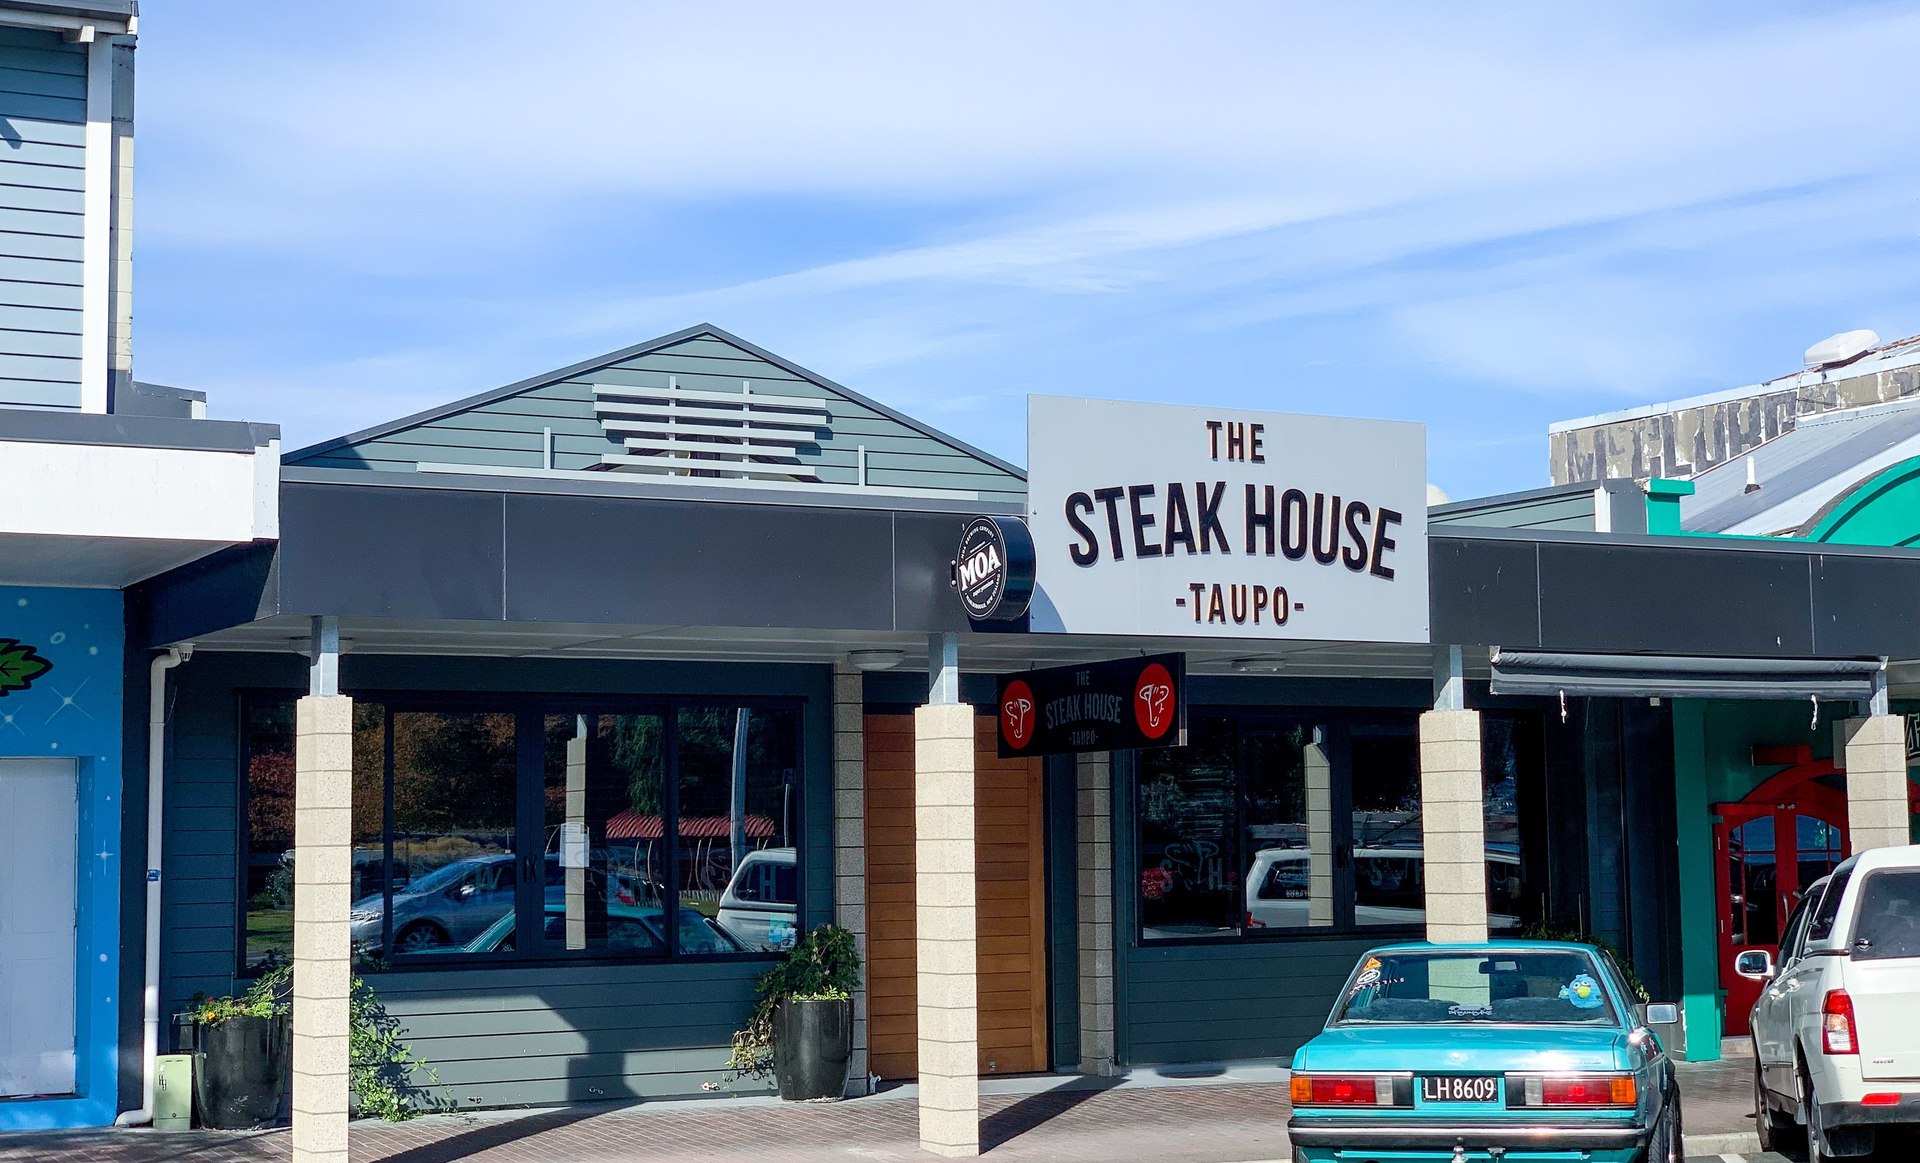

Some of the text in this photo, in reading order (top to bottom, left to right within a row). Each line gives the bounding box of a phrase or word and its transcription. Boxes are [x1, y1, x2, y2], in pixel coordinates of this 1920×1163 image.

[1207, 420, 1266, 463] THE
[1065, 480, 1403, 581] STEAK HOUSE
[959, 544, 1002, 592] MOA
[1176, 582, 1305, 626] -TAUPO-
[1076, 671, 1090, 686] THE
[1046, 693, 1122, 729] STEAK HOUSE
[1424, 1078, 1495, 1099] LH8609
